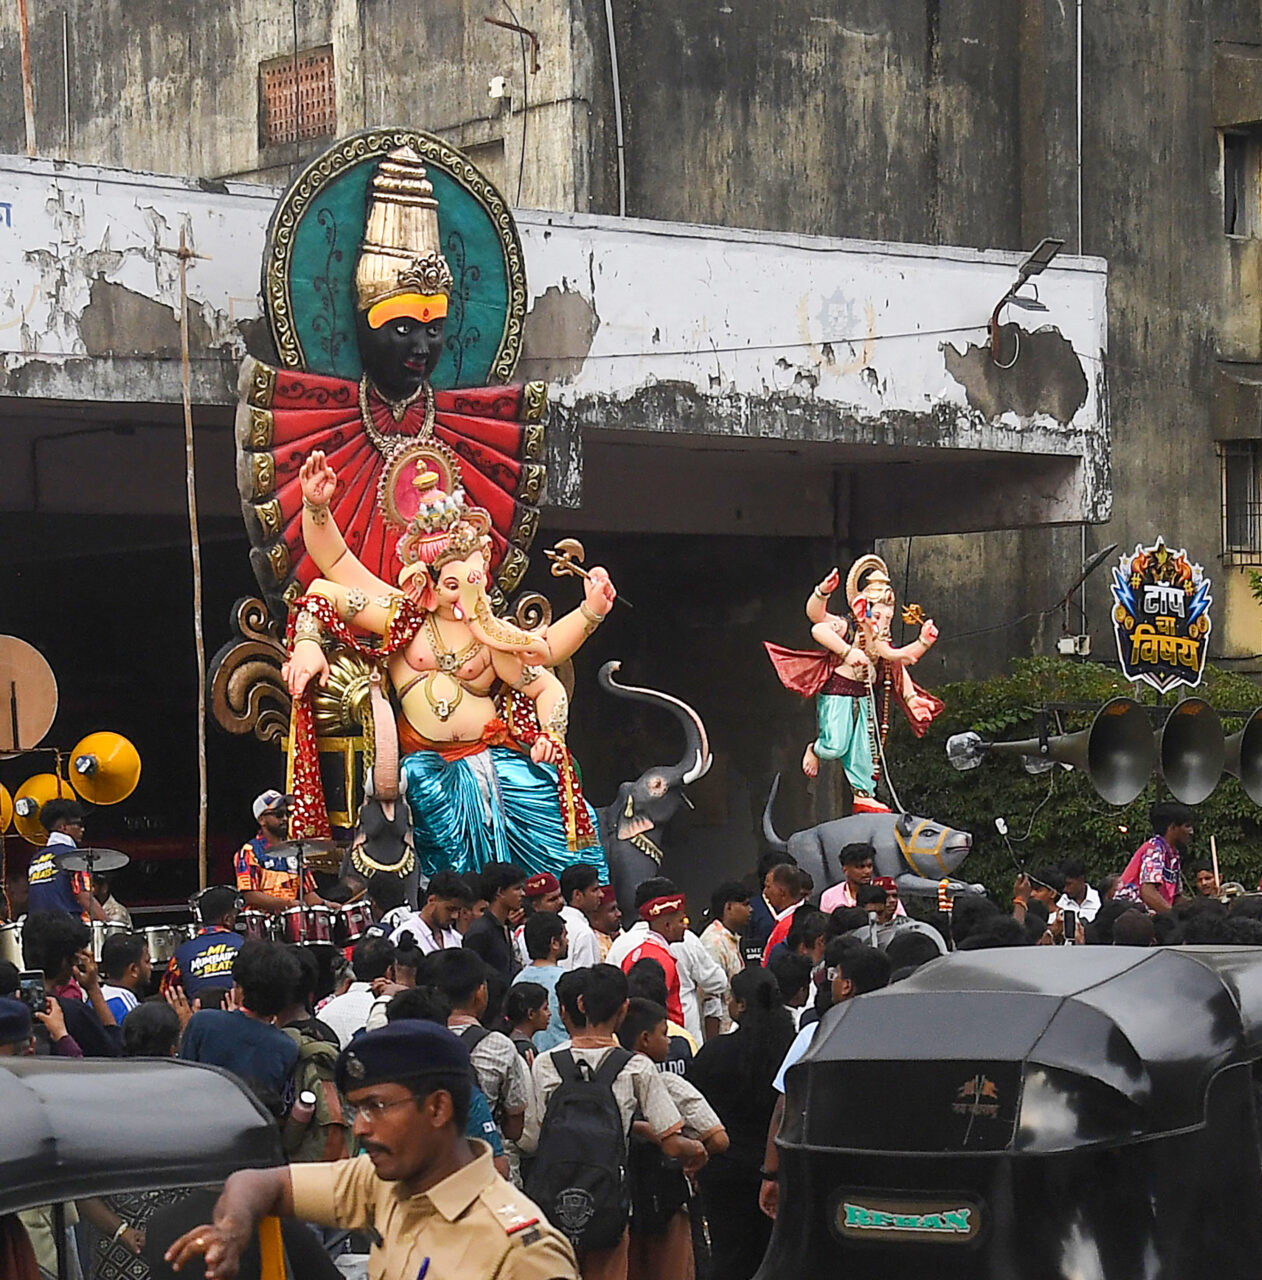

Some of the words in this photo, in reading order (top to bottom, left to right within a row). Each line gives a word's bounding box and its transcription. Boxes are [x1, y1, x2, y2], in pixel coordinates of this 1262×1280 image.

[1144, 581, 1185, 618] टॉप
[1129, 624, 1200, 671] विषय
[206, 944, 226, 956] MI
